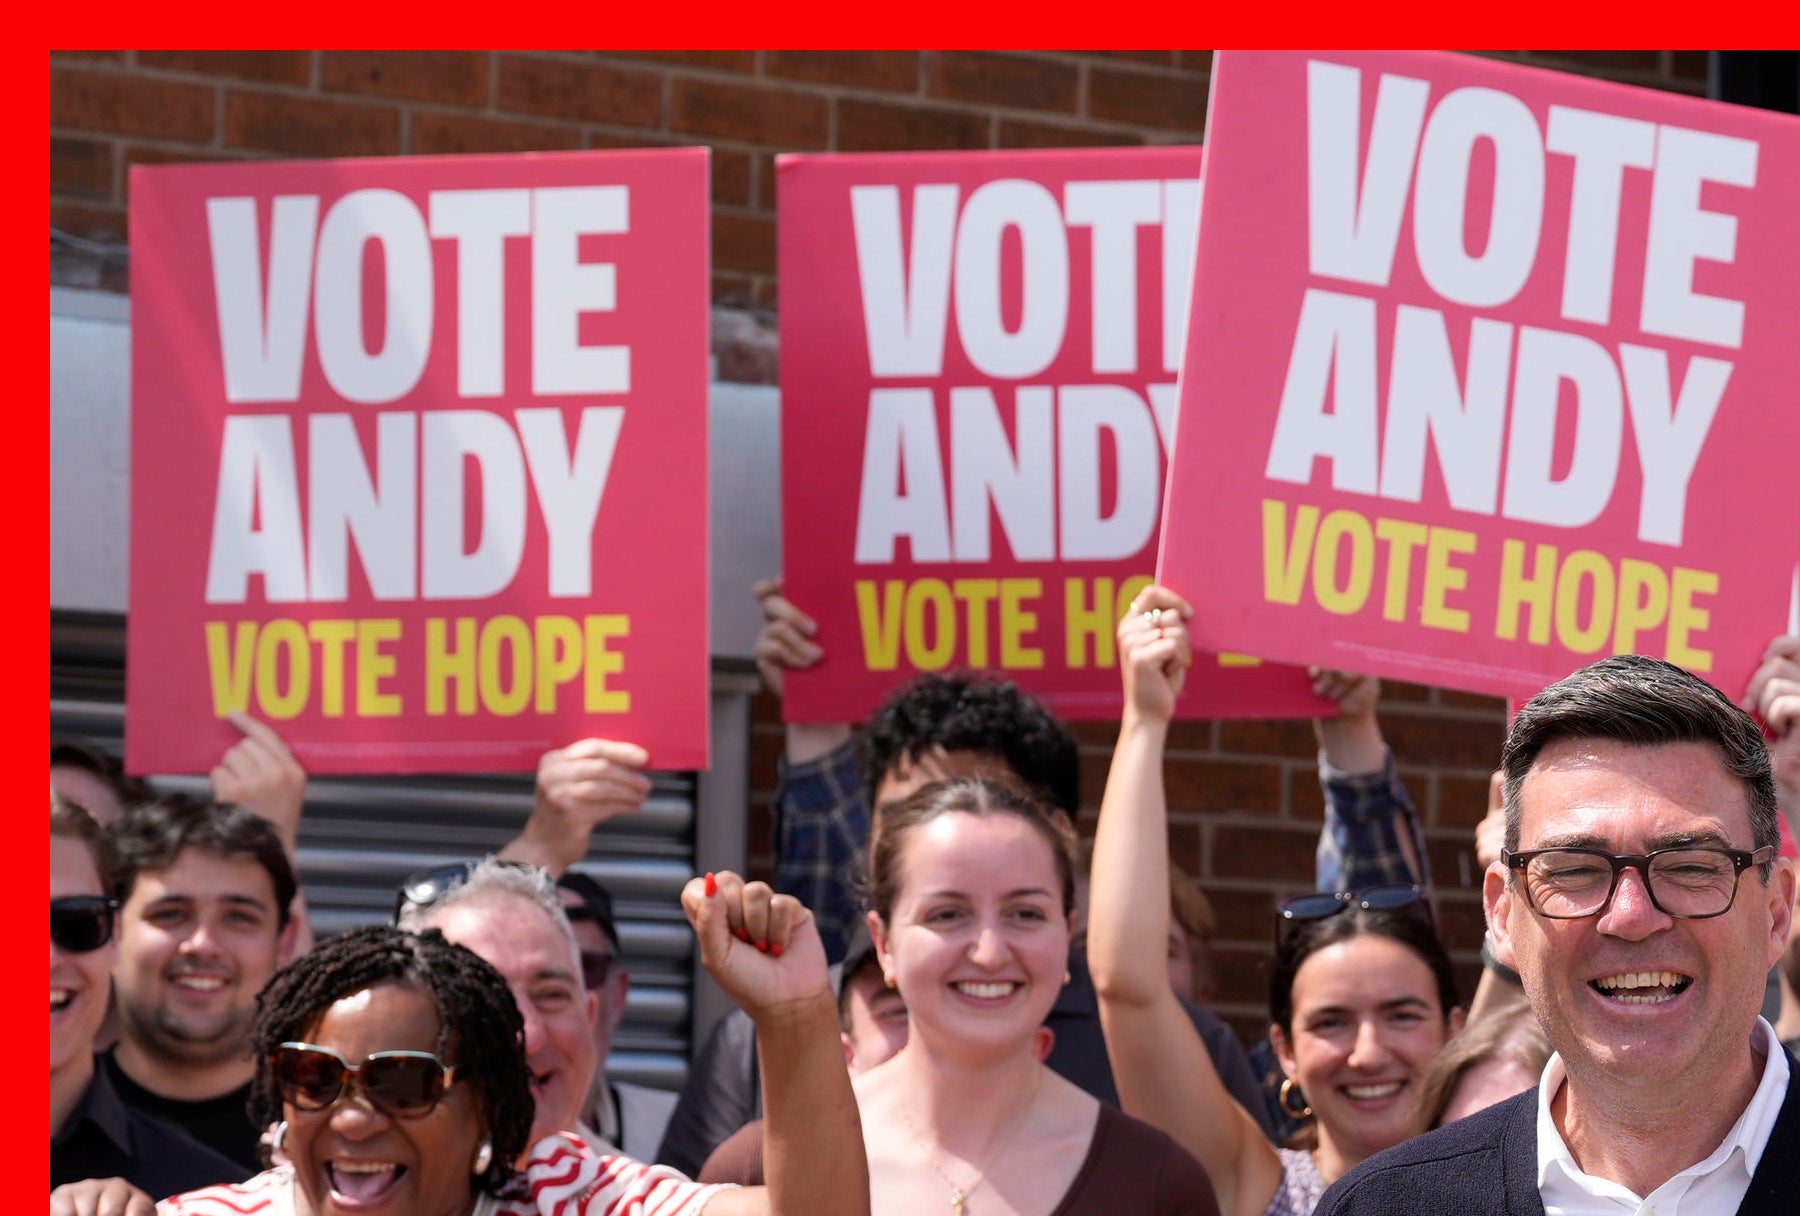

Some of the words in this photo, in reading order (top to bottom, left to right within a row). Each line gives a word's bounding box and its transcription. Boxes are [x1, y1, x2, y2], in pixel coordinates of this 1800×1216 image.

[206, 184, 632, 404] VOTE
[1307, 59, 1760, 349] VOTE
[205, 405, 626, 605] ANDY
[853, 383, 1177, 565] AND
[1264, 287, 1734, 547] ANDY
[205, 617, 402, 720] VOTE
[425, 614, 630, 717] HOPE
[855, 577, 1044, 672] VOTE
[1261, 498, 1477, 632] VOTE
[1494, 519, 1720, 674] HOPE
